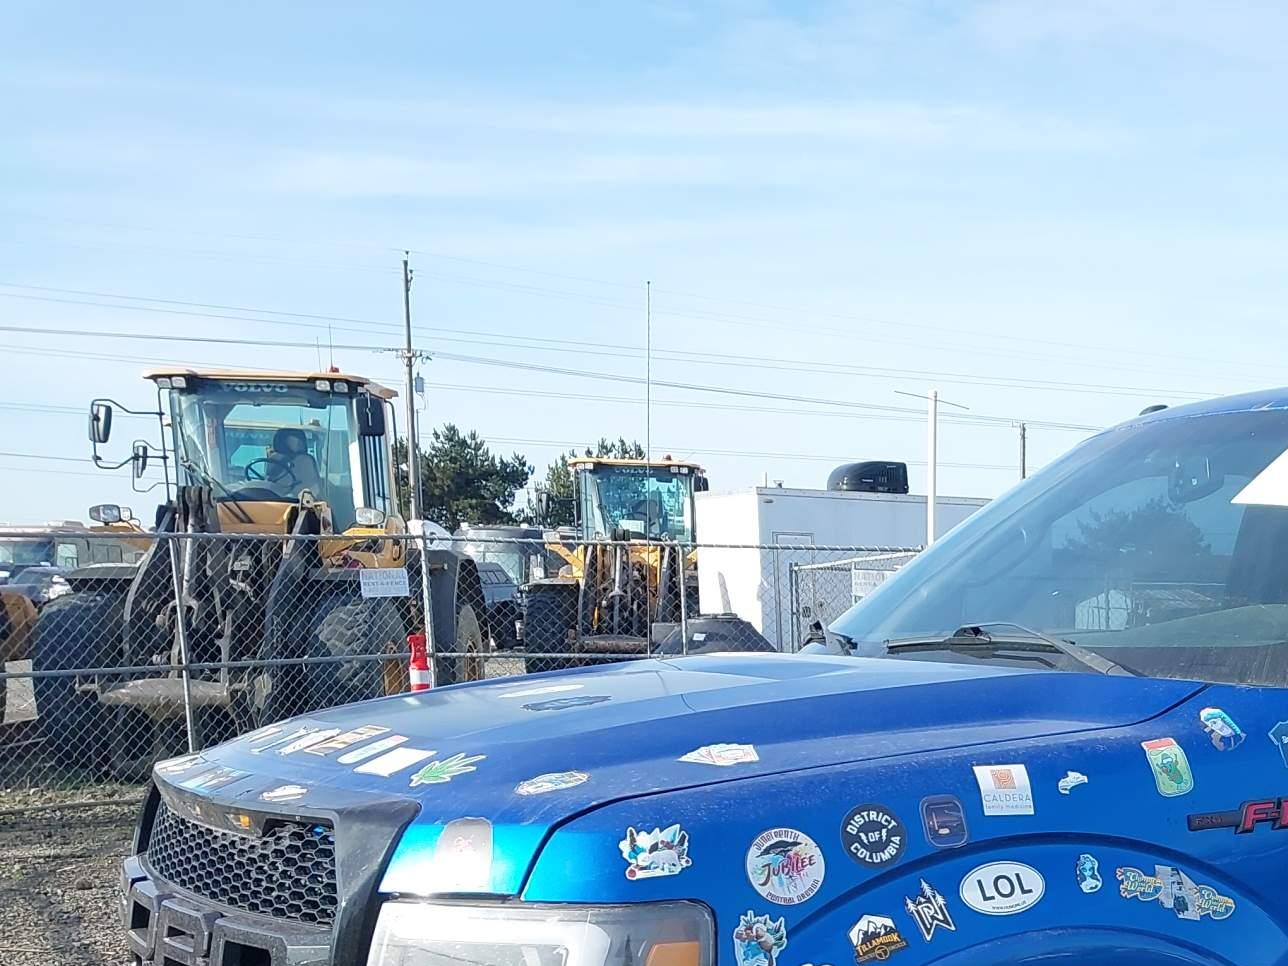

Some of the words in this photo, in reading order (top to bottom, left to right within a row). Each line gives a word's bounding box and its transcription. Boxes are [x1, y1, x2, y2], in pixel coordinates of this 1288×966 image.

[224, 382, 288, 392] VOLVO
[983, 794, 1032, 803] CALDERA
[846, 810, 898, 835] DISTRICT
[868, 831, 881, 842] OF
[850, 836, 902, 864] COLUMBIA
[758, 853, 817, 887] JUBILEE
[976, 873, 1034, 902] LOL
[856, 932, 901, 956] TILLAMOOK
